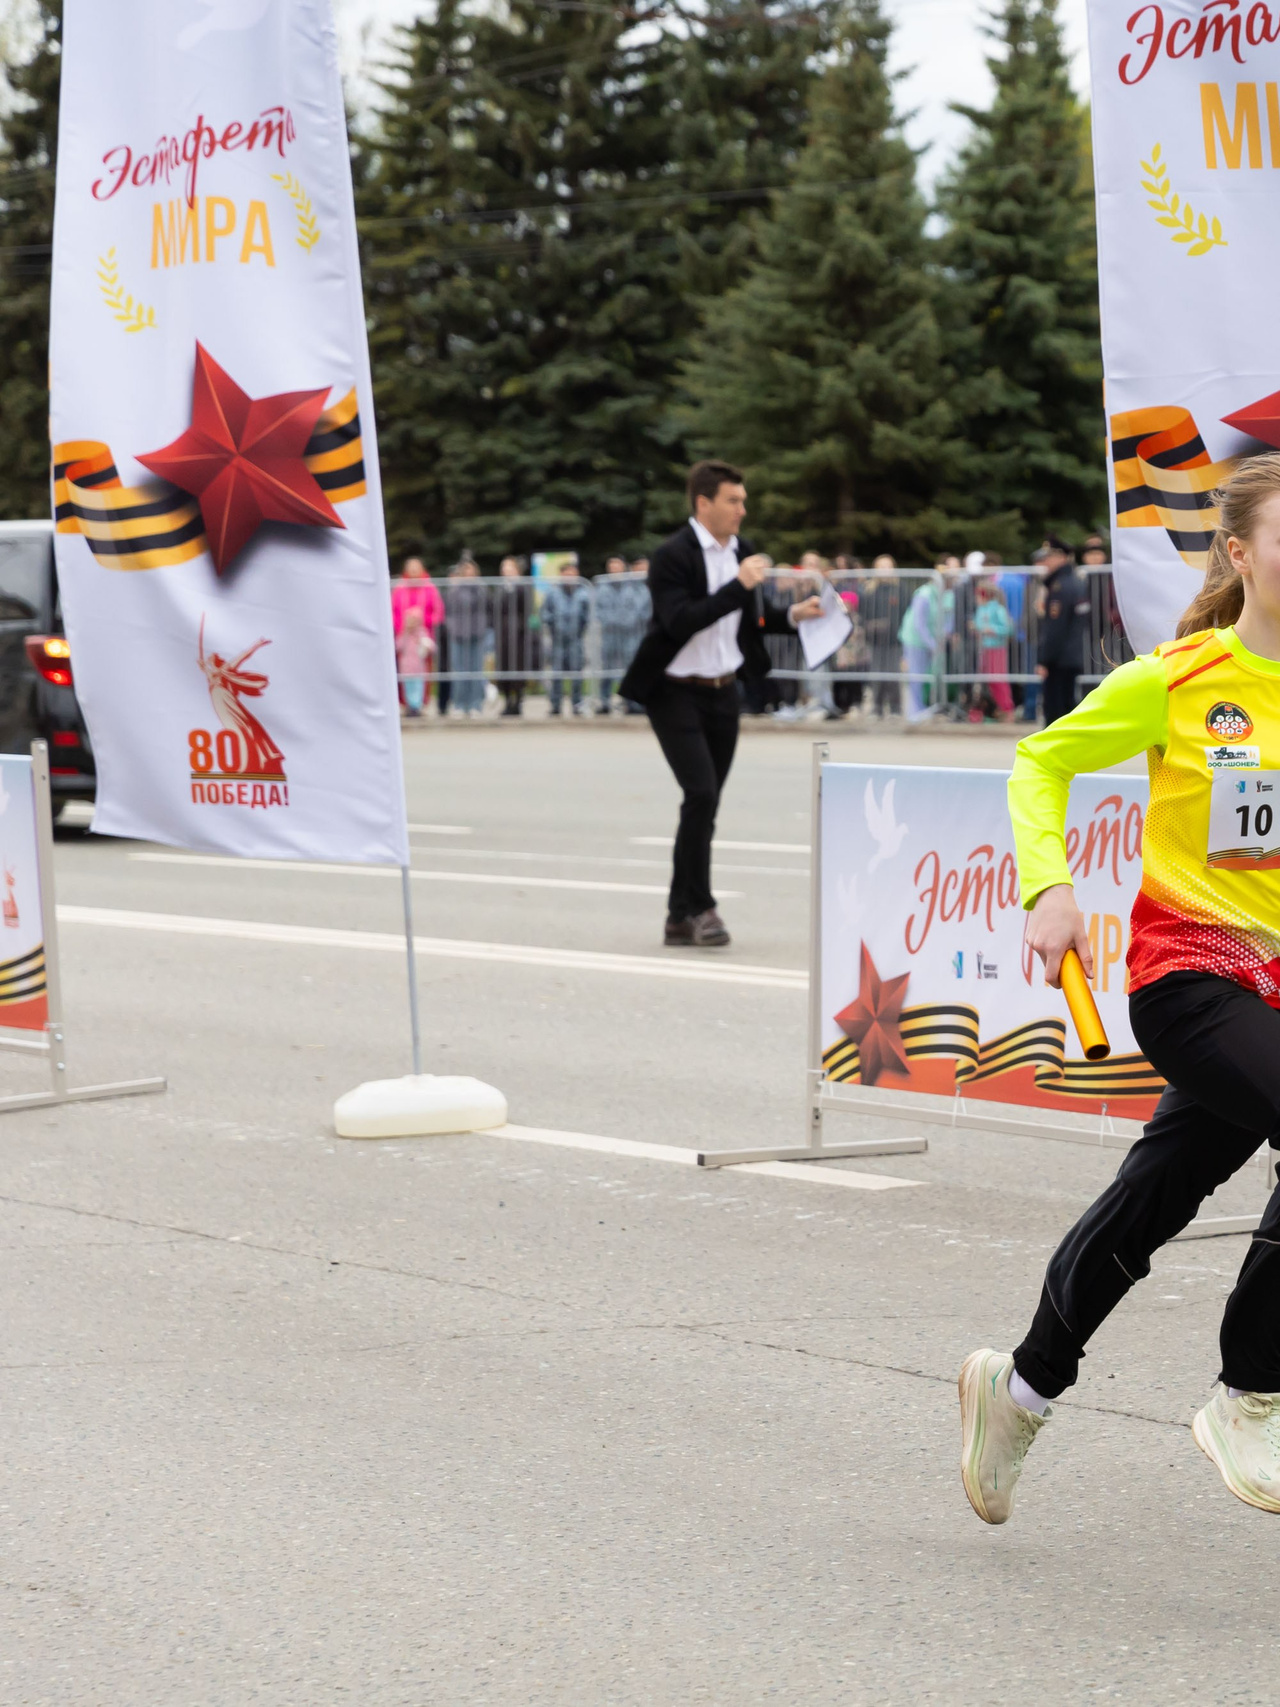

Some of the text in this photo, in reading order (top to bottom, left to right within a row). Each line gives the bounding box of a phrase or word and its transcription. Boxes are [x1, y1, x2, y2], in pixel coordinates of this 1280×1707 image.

[91, 105, 297, 211] Эстафета
[150, 195, 276, 270] МИРА
[188, 728, 242, 774] 80
[190, 782, 289, 810] ПОБЕДА!
[1235, 803, 1274, 837] 10
[904, 794, 1144, 987] Эстаета
